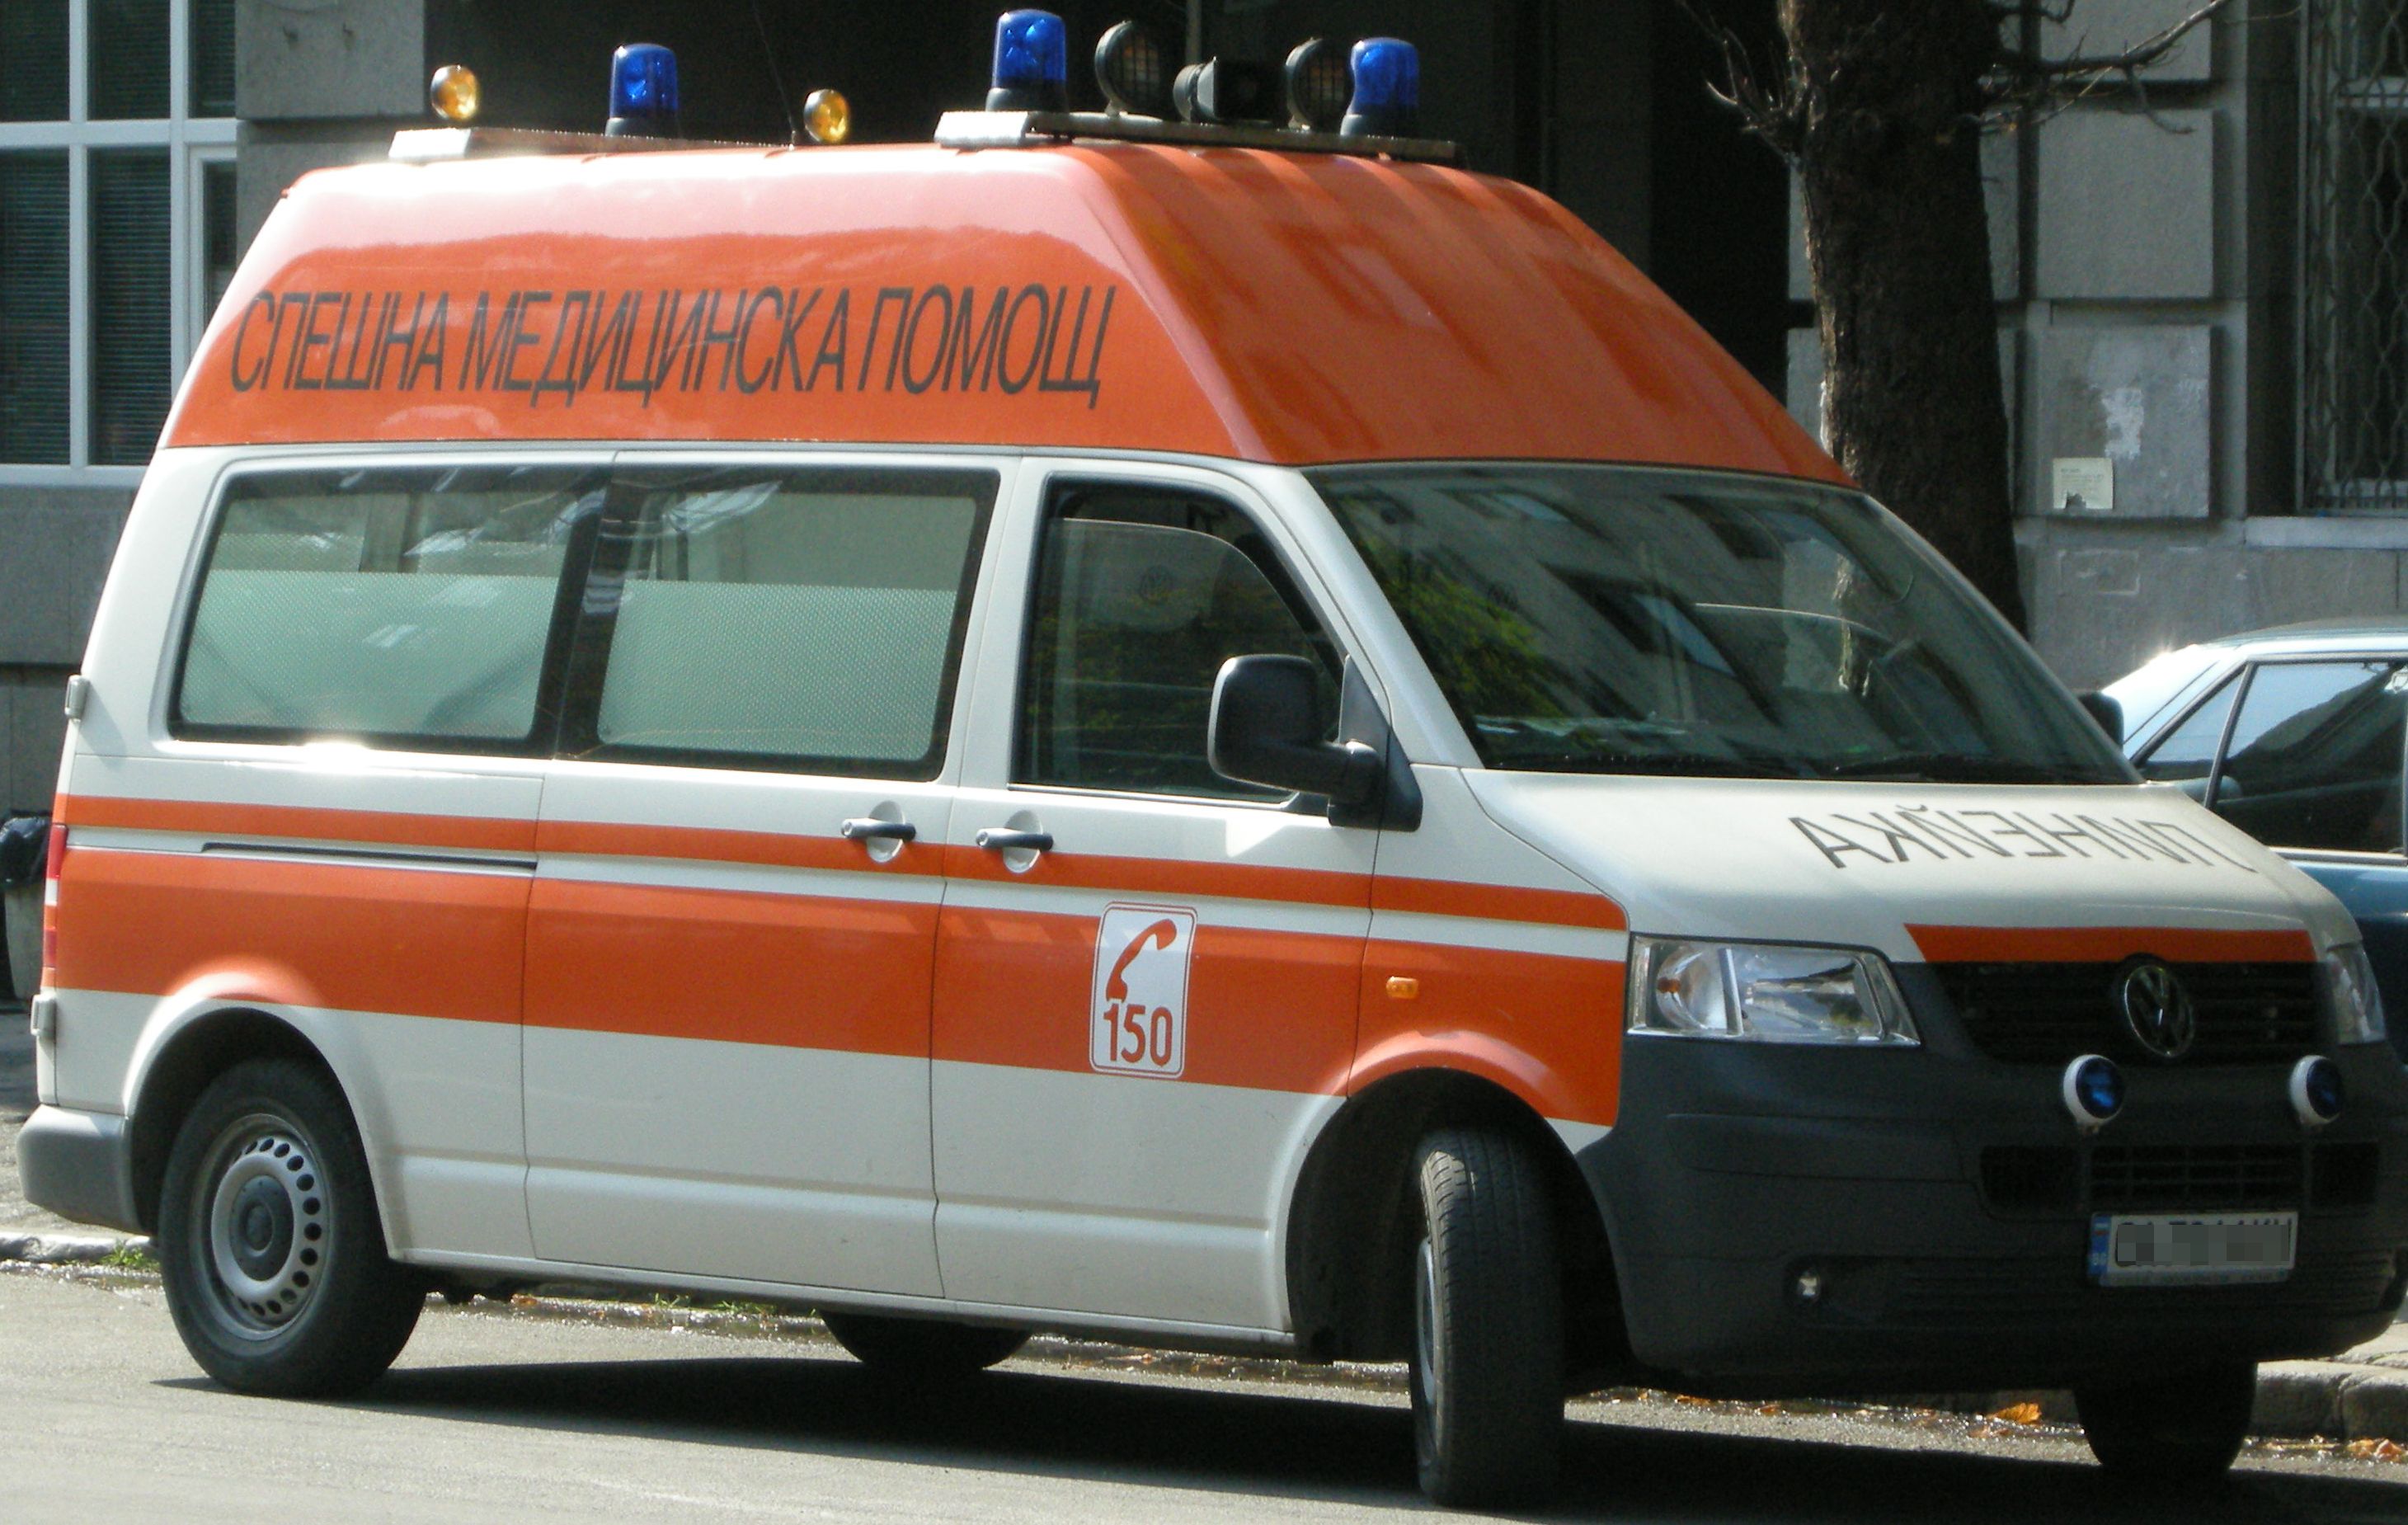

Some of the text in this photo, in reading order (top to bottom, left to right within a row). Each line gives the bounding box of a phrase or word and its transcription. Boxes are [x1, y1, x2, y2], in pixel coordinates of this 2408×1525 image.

[231, 284, 1116, 411] СПЕШНА МЕДИЦИНСКА ПОМОЩ
[1103, 1002, 1173, 1068] 150
